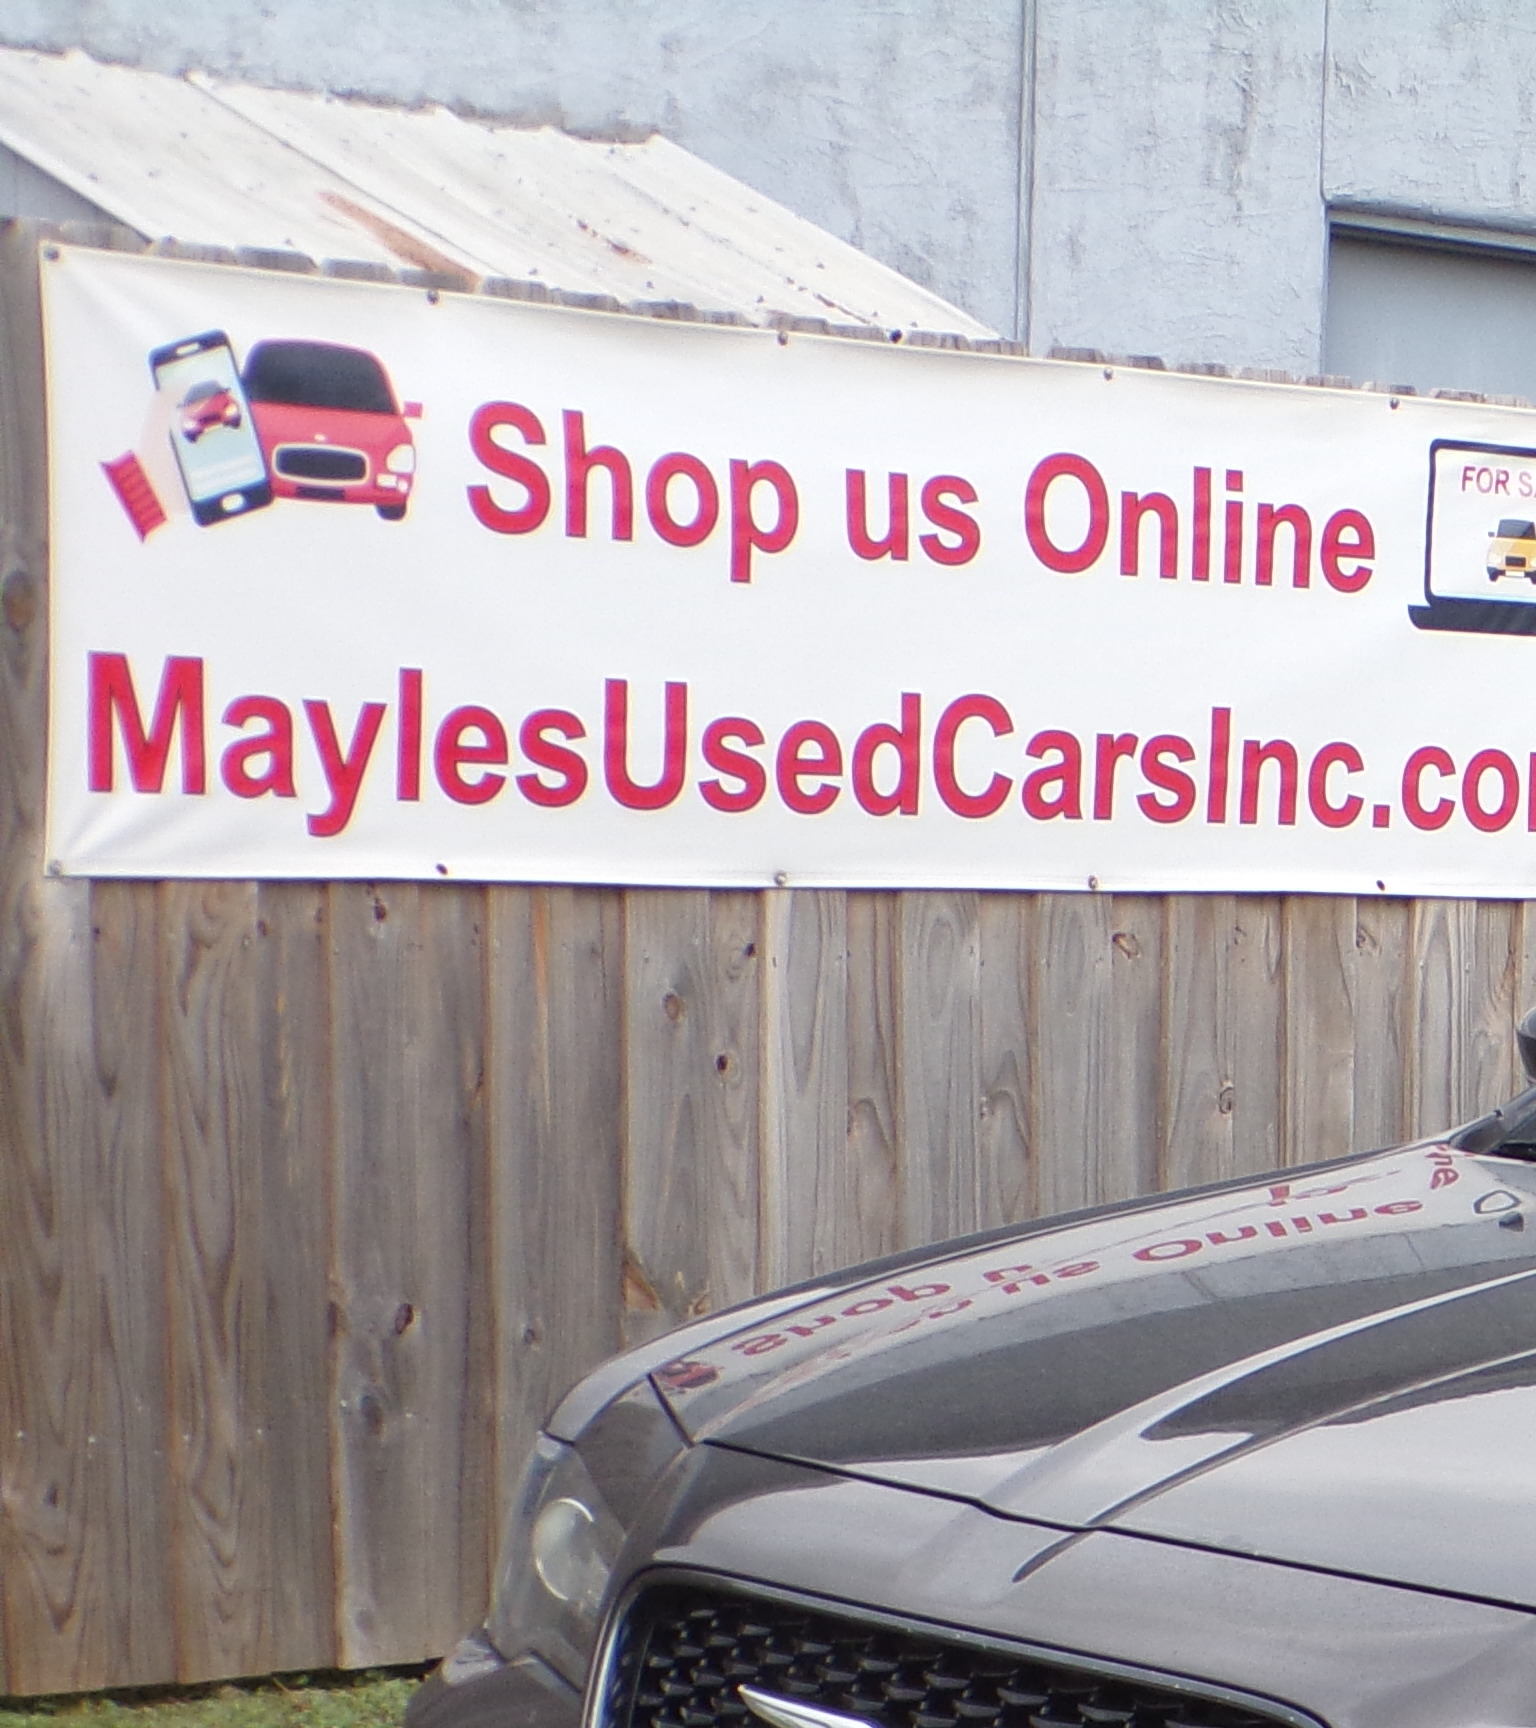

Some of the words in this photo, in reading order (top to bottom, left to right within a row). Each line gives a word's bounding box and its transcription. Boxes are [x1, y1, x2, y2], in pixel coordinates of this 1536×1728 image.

[466, 400, 799, 583] Shop
[845, 468, 981, 566] us
[1023, 453, 1376, 593] Online
[1462, 466, 1510, 496] FOR
